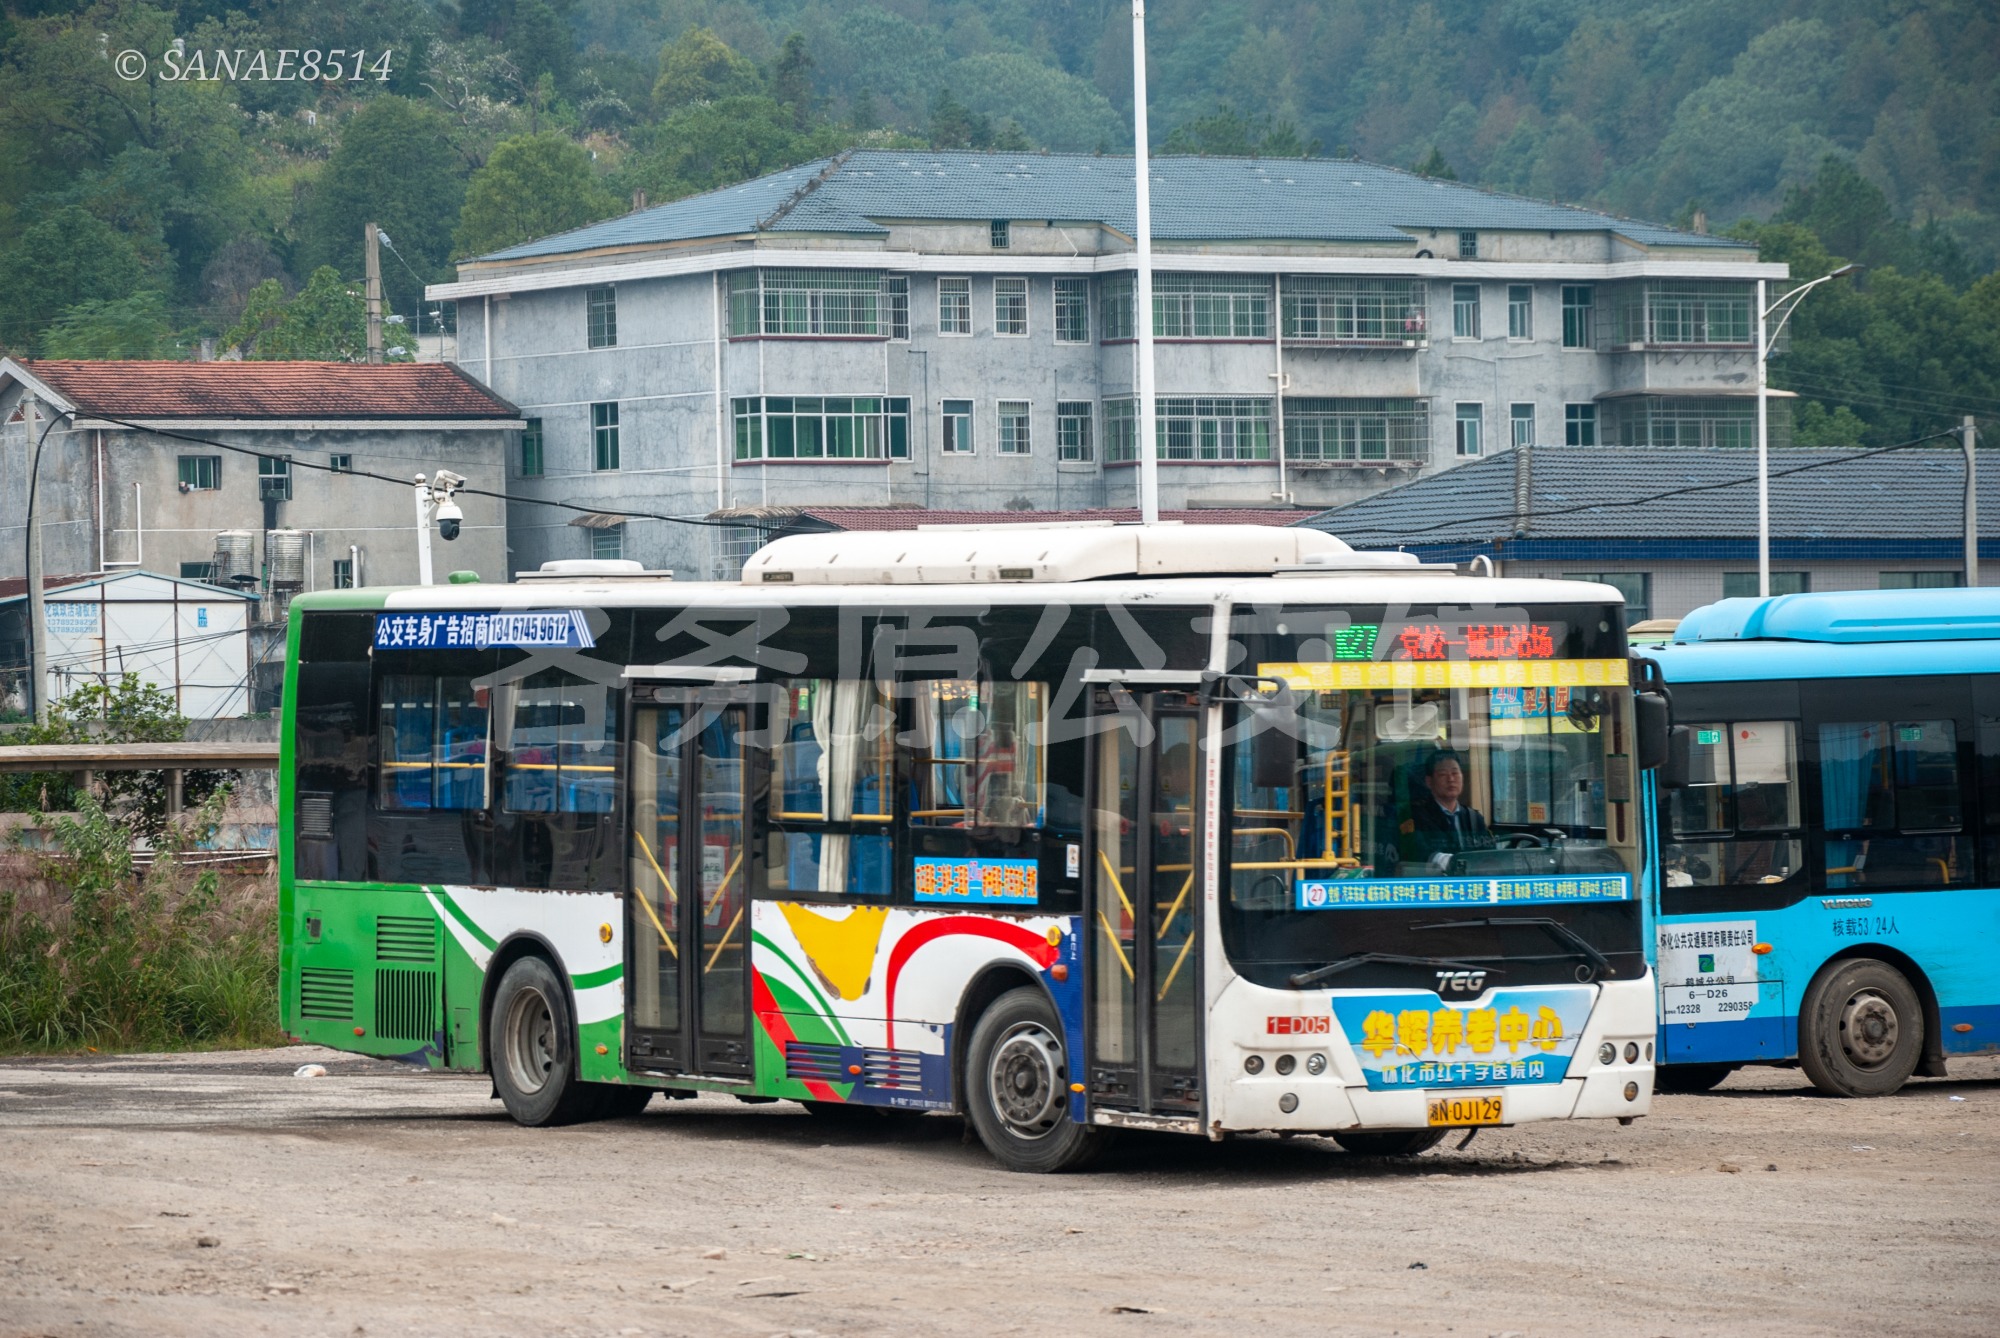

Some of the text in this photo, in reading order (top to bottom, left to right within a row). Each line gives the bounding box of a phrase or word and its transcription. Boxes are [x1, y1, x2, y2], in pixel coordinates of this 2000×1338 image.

[377, 615, 490, 646] 公交车身广告招商
[1311, 888, 1323, 902] 27
[1821, 898, 1873, 910] YUTONG
[1832, 916, 1900, 937] 核载53/24人
[1660, 929, 1754, 950] 怀化公共交通集团有限责任公司
[1436, 971, 1487, 992] TEG
[1676, 1004, 1701, 1014] 12328
[1269, 1016, 1329, 1034] 1-D05
[1362, 1005, 1564, 1058] 华辉养老中心
[1381, 1060, 1545, 1084] 怀化市红十字医院内
